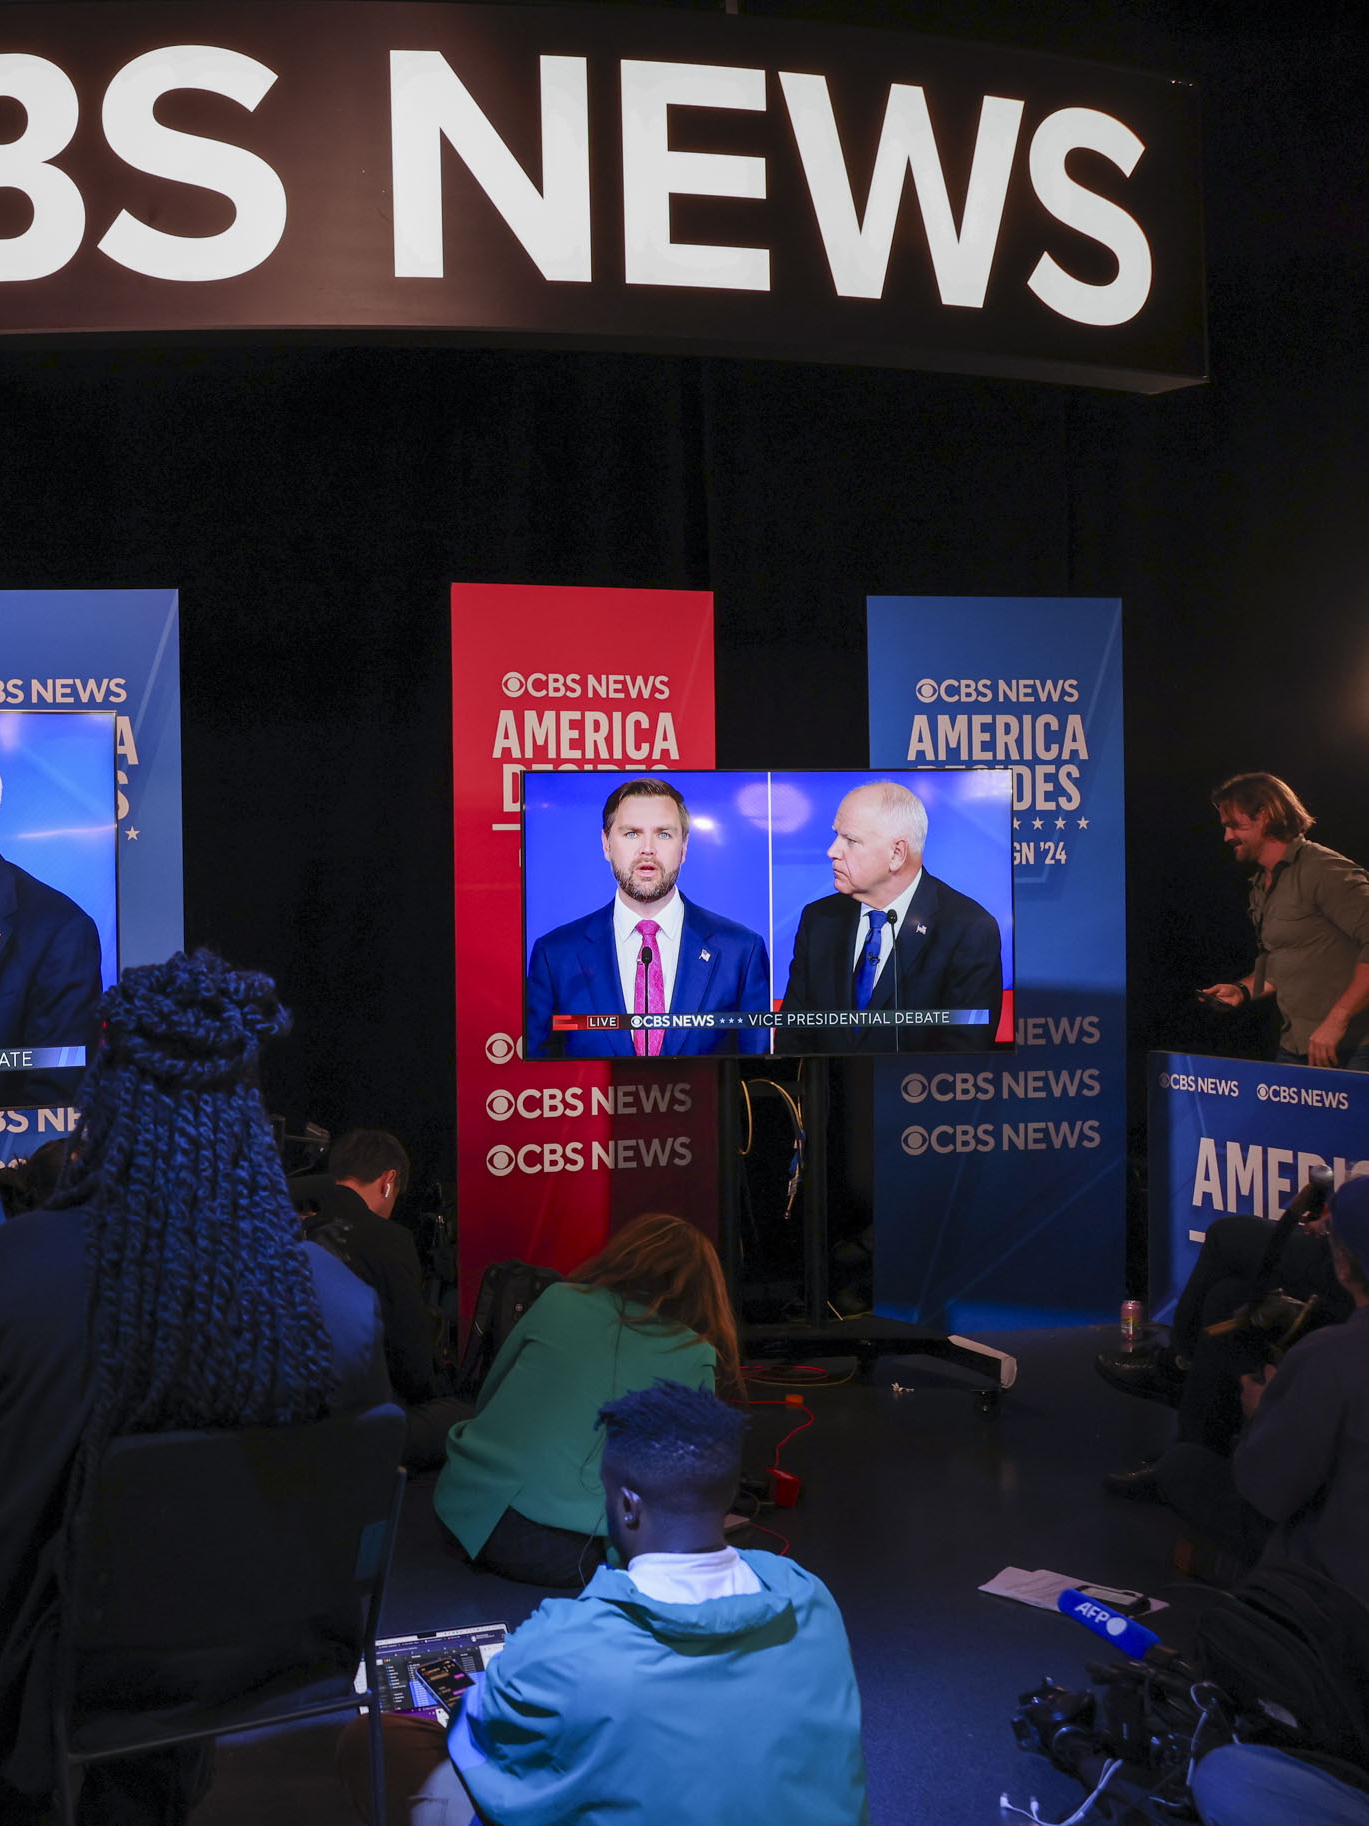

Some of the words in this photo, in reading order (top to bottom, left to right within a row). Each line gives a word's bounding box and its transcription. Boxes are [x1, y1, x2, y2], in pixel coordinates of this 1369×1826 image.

[390, 50, 1151, 325] NEWS
[31, 678, 128, 703] NEWS
[527, 672, 582, 698] CBS
[587, 674, 671, 700] NEWS
[940, 679, 993, 703] CBS
[998, 679, 1080, 703] NEWS
[492, 709, 680, 760] AMERICA
[907, 714, 1089, 761] AMERICA
[1039, 841, 1067, 865] '24
[589, 1016, 617, 1028] LIVE
[643, 1015, 671, 1027] CBS
[672, 1014, 715, 1027] NEWS
[748, 1013, 783, 1026] VICE
[787, 1011, 891, 1026] PRESIDENTIAL
[894, 1011, 950, 1025] DEBATE
[930, 1072, 996, 1102] CBS
[1002, 1068, 1101, 1099] NEWS
[1170, 1073, 1195, 1092] CBS
[1197, 1077, 1239, 1097] NEWS
[1269, 1085, 1298, 1104] CBS
[1301, 1089, 1349, 1110] NEWS
[516, 1086, 584, 1119] CBS
[591, 1082, 692, 1116] NEWS
[930, 1123, 996, 1154] CBS
[1002, 1119, 1101, 1151] NEWS
[516, 1141, 584, 1174] CBS
[591, 1136, 693, 1170] NEWS
[1074, 1602, 1111, 1623] AFP
